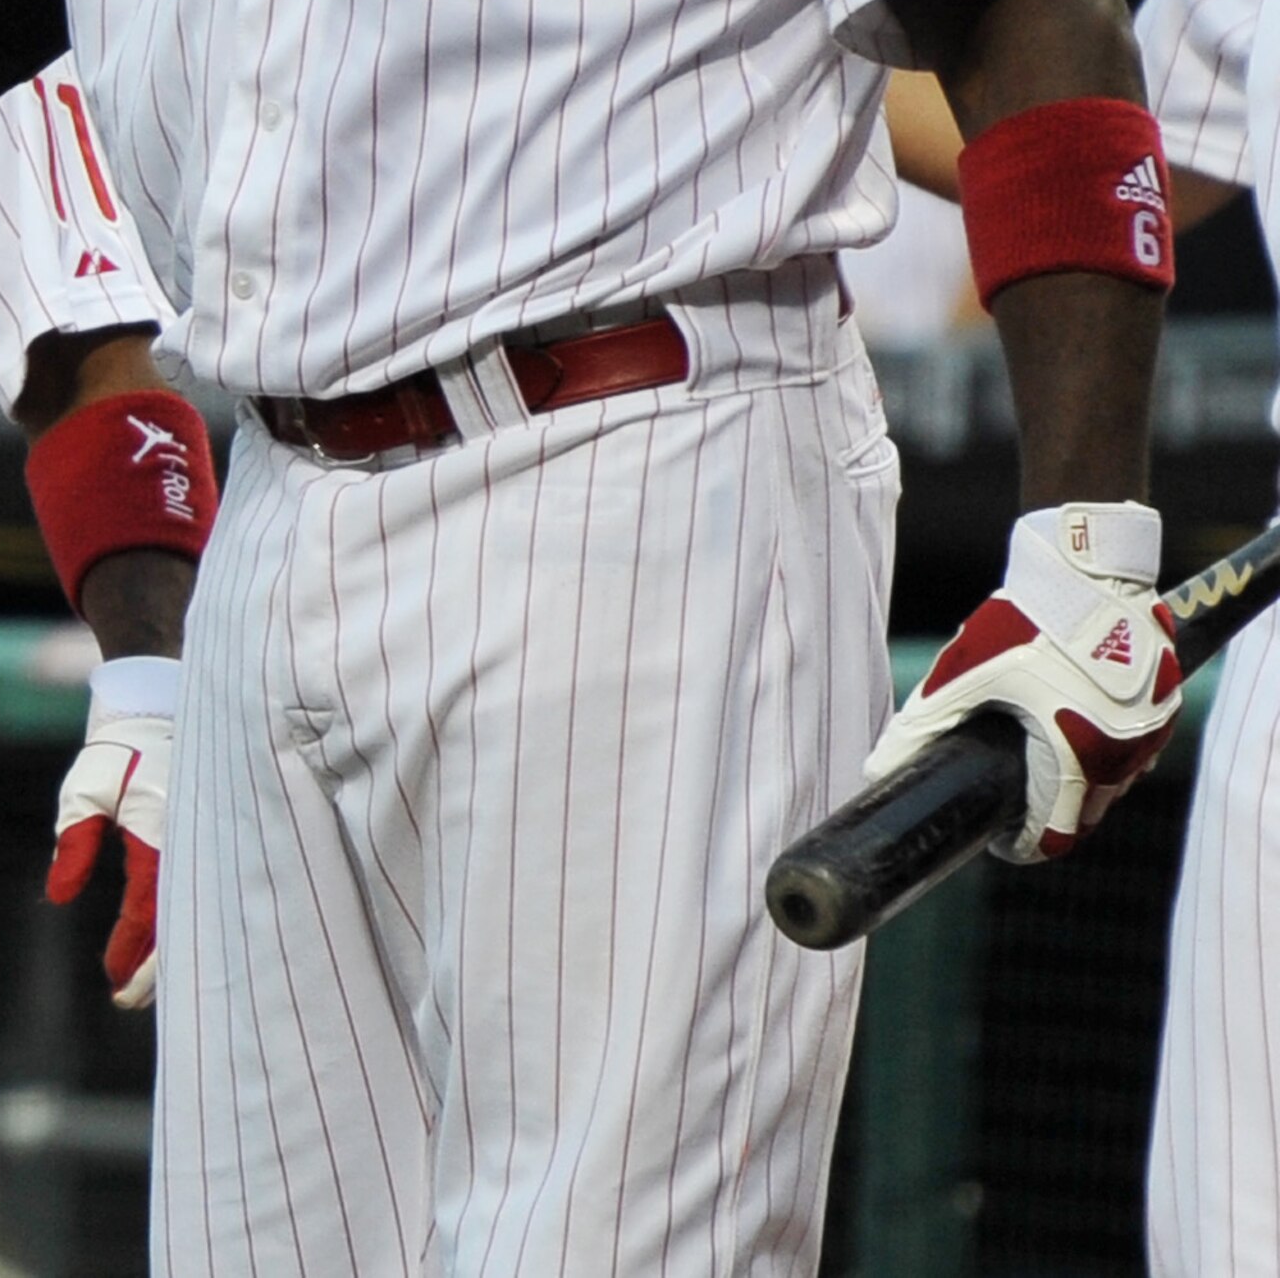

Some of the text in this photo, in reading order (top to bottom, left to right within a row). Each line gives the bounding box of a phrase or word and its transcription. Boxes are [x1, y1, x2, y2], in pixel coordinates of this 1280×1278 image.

[33, 76, 119, 223] 11
[1115, 184, 1166, 213] adida
[1133, 210, 1160, 266] 6
[1070, 516, 1090, 552] TS
